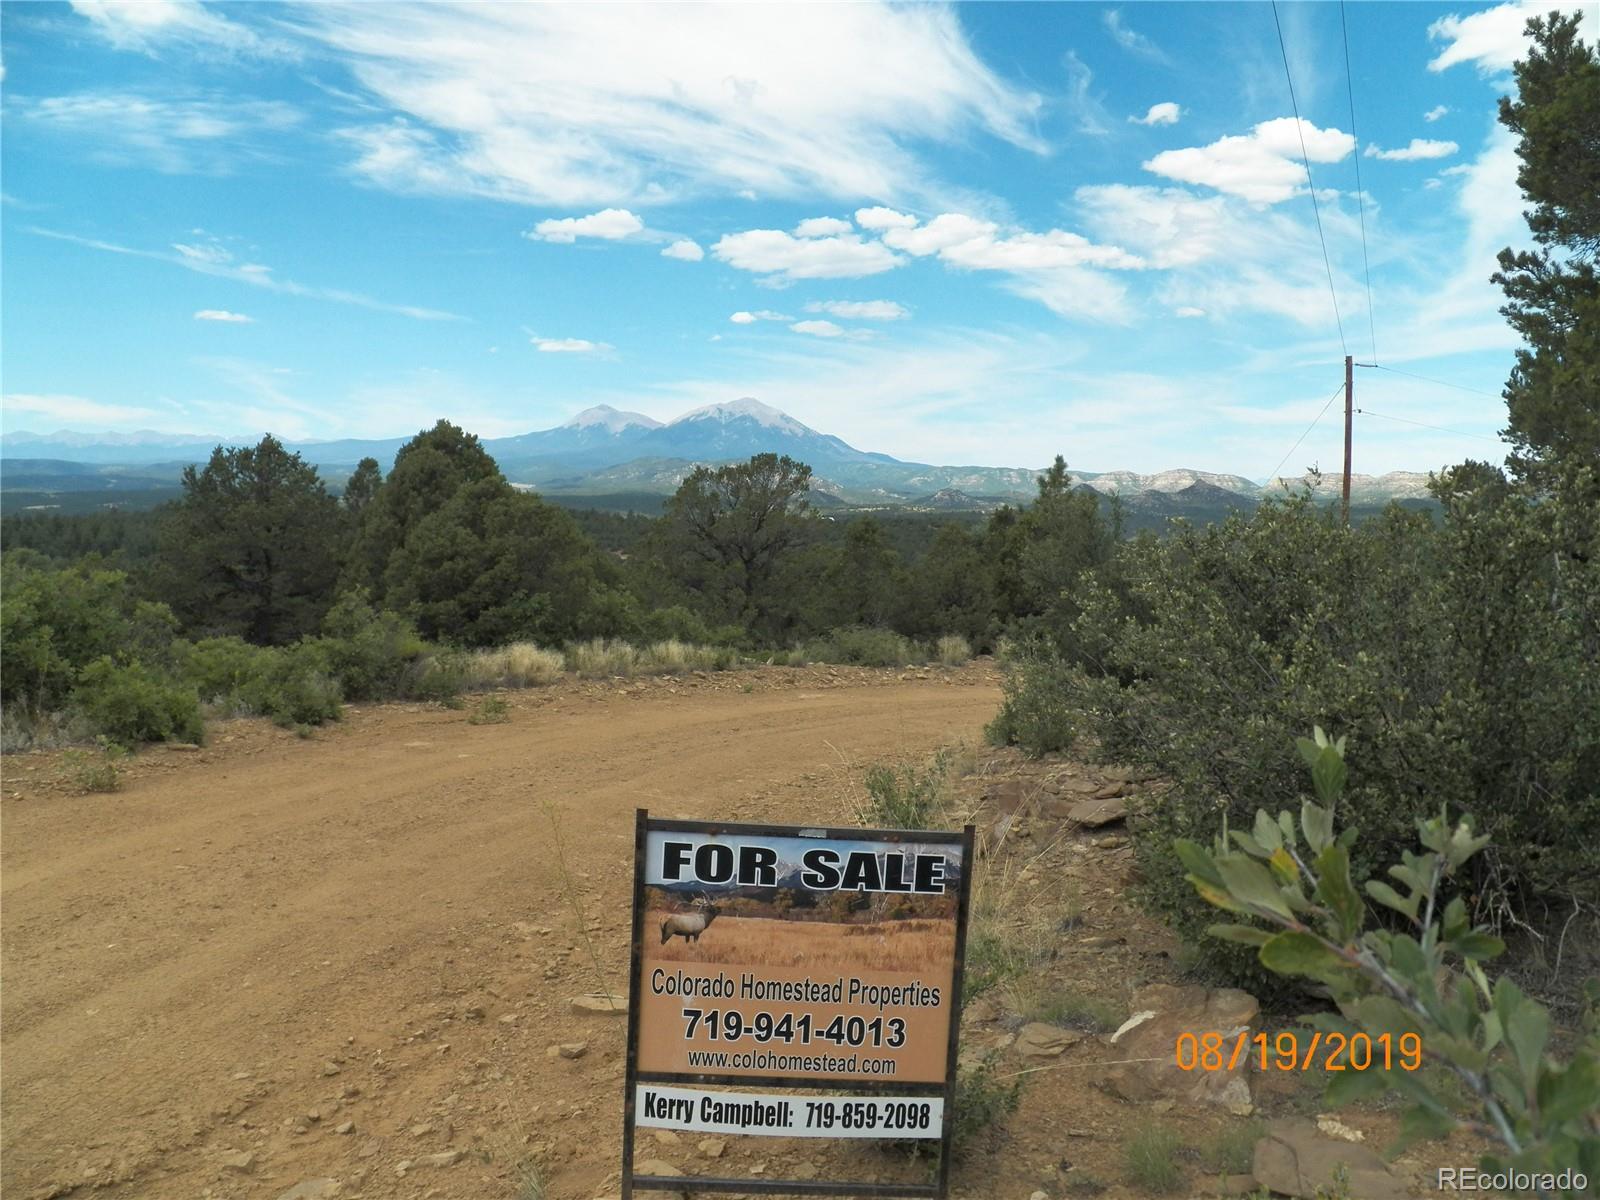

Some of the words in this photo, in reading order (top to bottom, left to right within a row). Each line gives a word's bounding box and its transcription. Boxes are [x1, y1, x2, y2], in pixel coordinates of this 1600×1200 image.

[662, 841, 777, 887] FOR
[801, 848, 946, 894] SALE
[651, 968, 734, 997] Colorado
[741, 973, 842, 1003] Homestead
[848, 978, 941, 1010] Properties
[682, 1009, 906, 1048] 719-941-4013
[688, 1050, 896, 1075] www.colohomestead.com
[644, 1092, 694, 1123] Kerry
[700, 1097, 793, 1128] Campbell:
[806, 1102, 930, 1129] 719-859-2098
